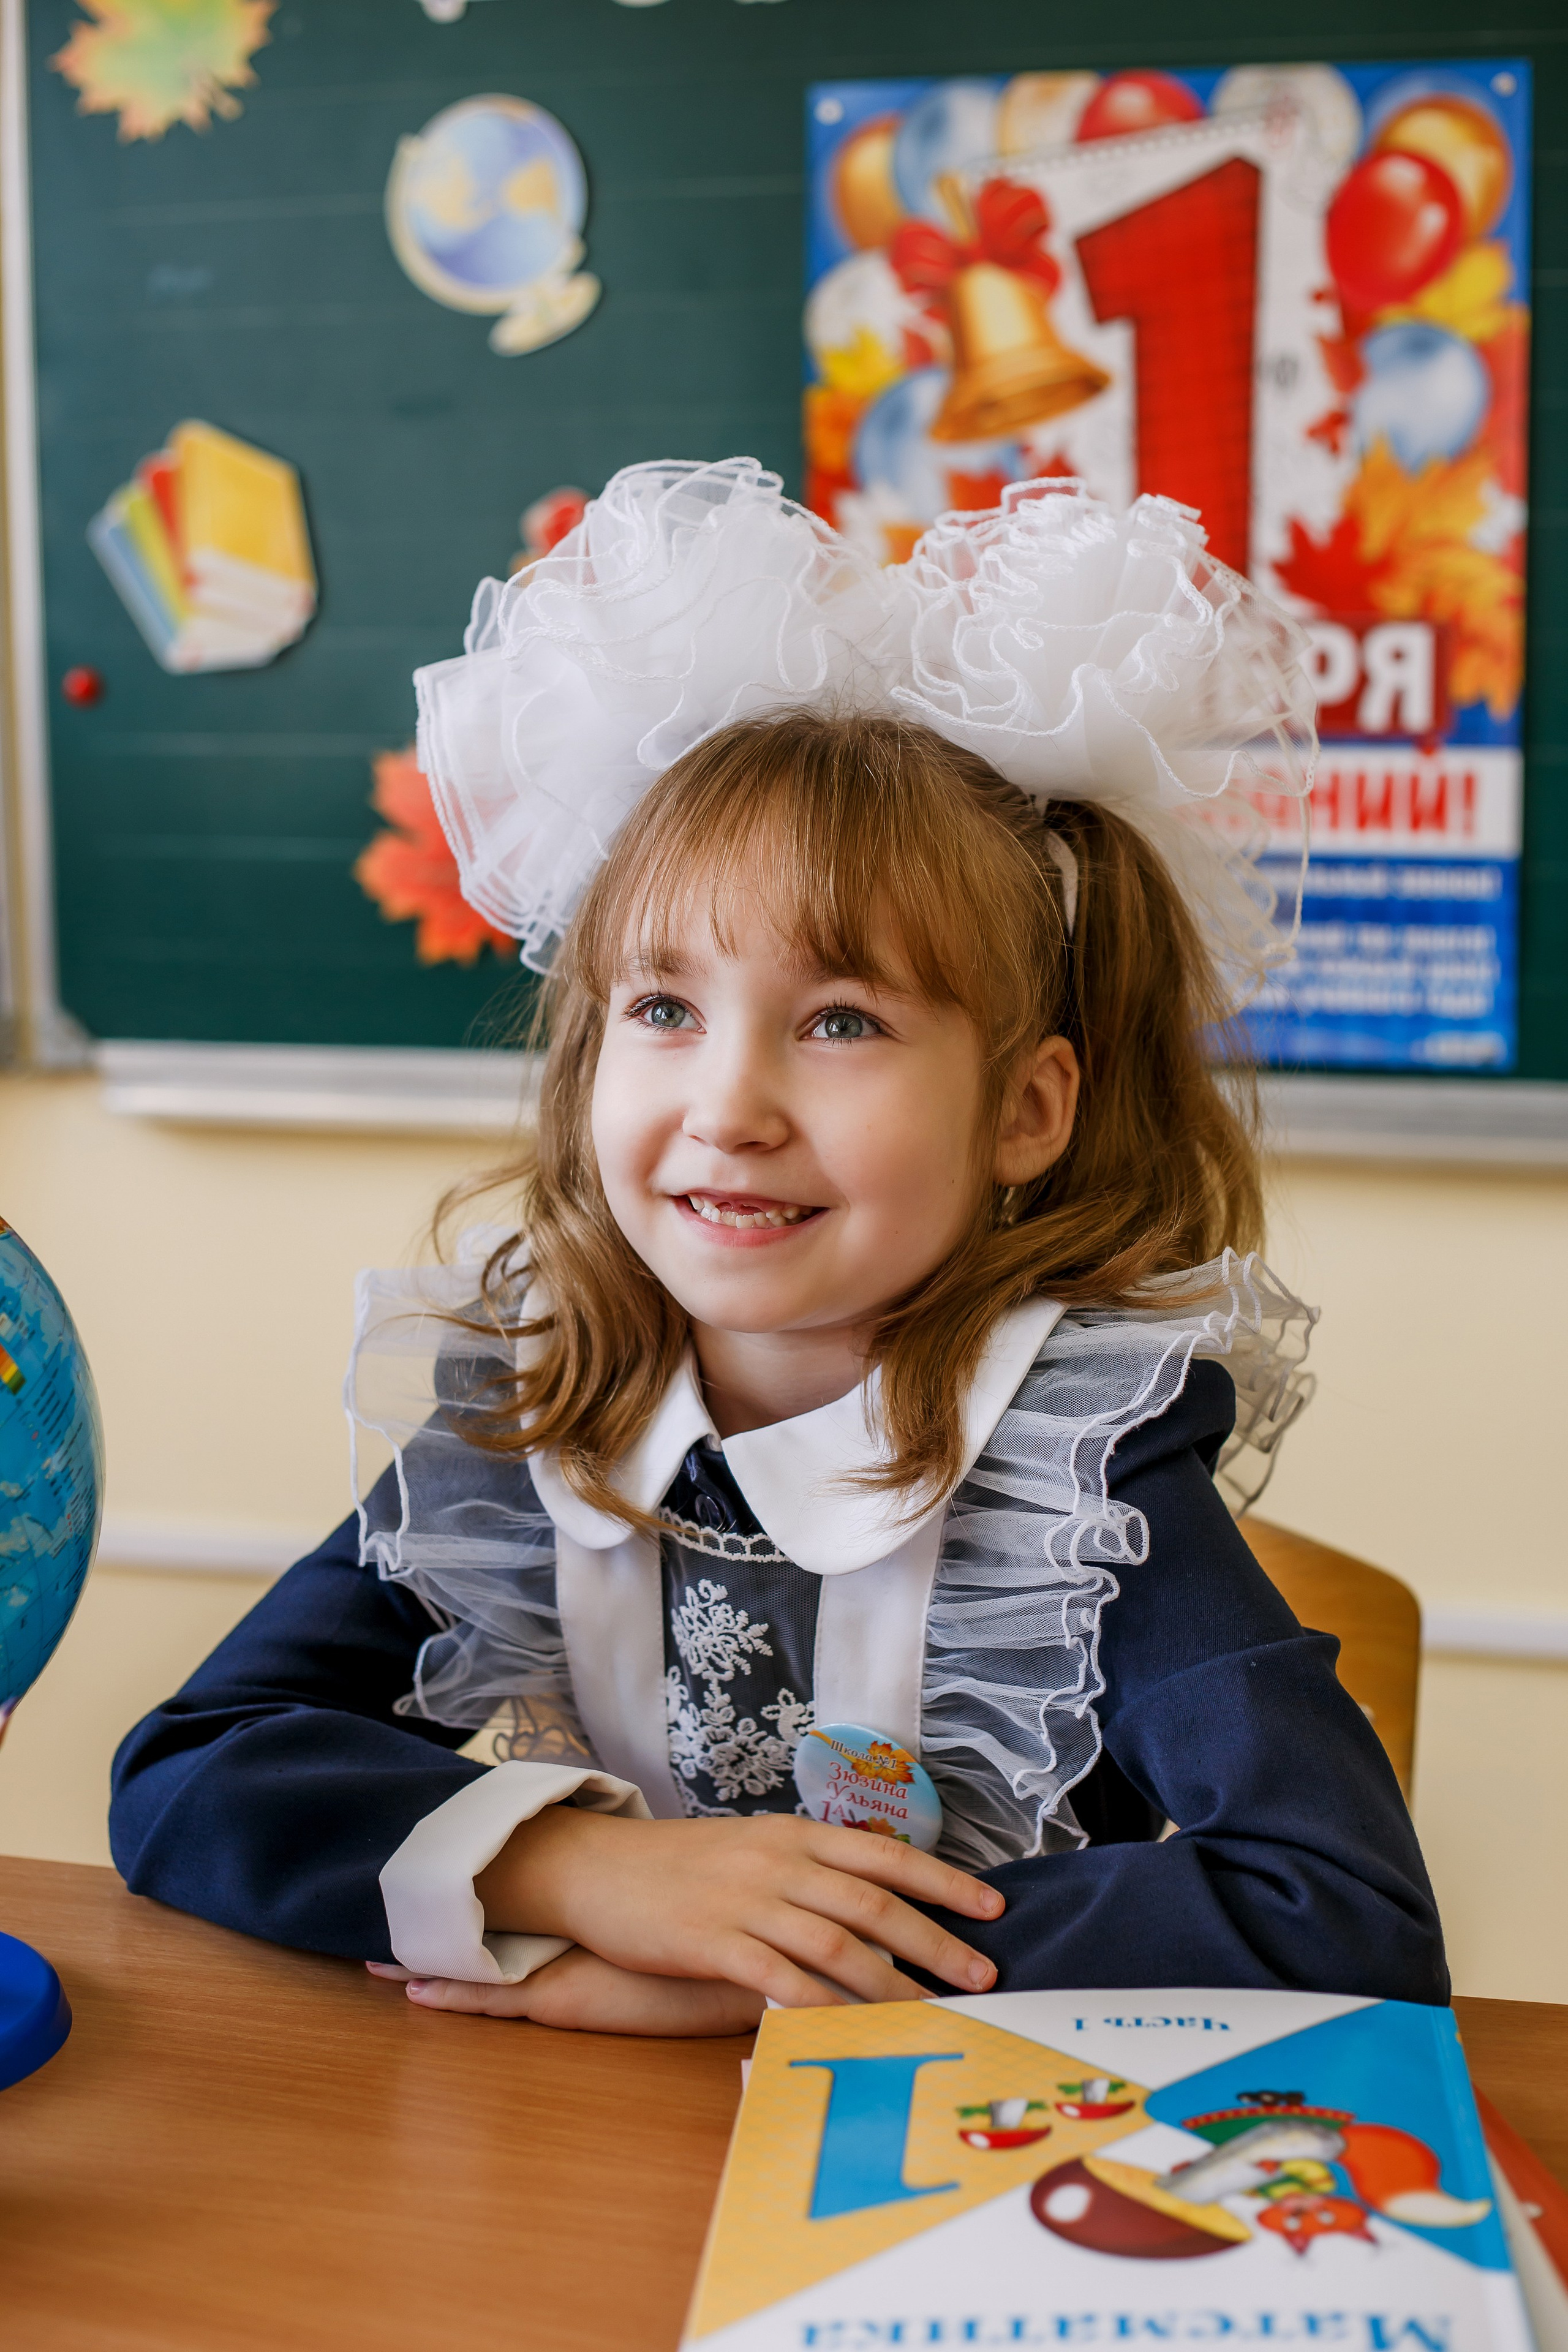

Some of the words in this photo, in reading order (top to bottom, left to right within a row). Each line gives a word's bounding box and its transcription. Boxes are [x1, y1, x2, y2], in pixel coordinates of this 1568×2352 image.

[1225, 620, 1436, 733] РЯ
[830, 1740, 874, 1763] Школа
[826, 1781, 908, 1819] Ульяна
[829, 1762, 908, 1800] Зюзина
[1102, 2017, 1231, 2031] Часть
[790, 2052, 963, 2220] 1
[799, 2309, 1453, 2352] Математика
